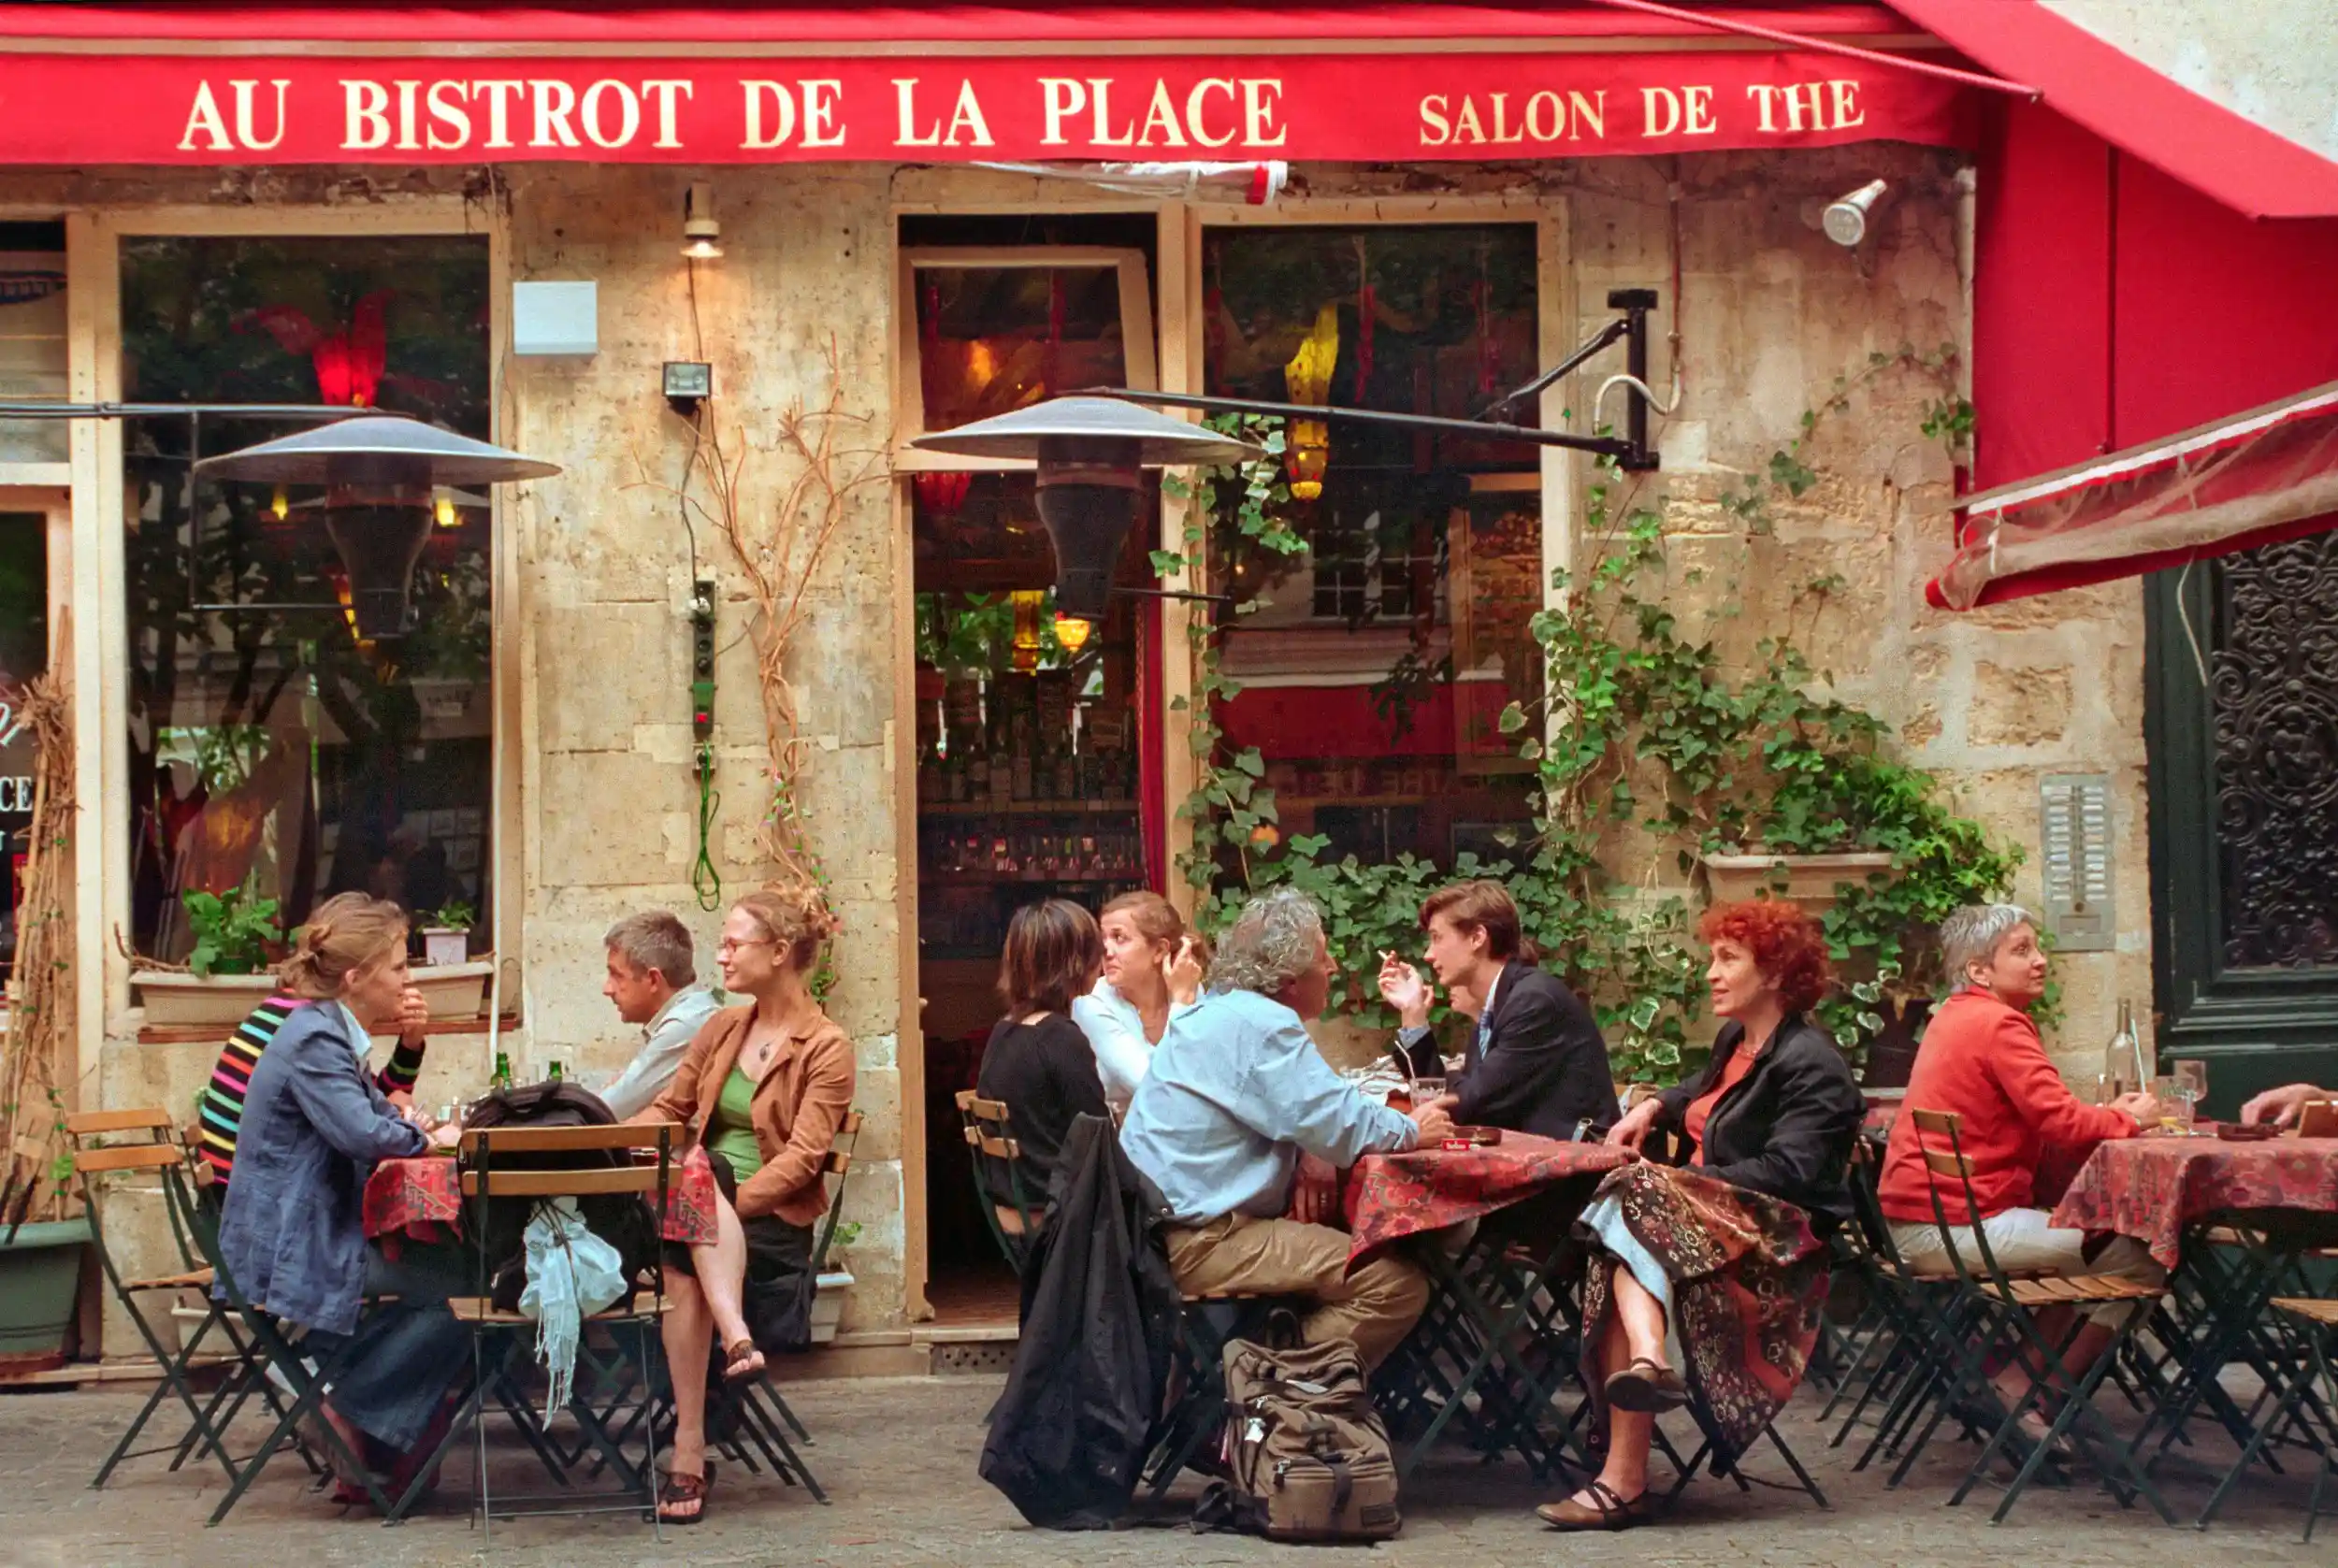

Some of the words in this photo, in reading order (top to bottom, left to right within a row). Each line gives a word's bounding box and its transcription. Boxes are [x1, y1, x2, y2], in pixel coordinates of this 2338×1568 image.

[176, 79, 292, 151] AU
[339, 79, 694, 151] BISTROT
[739, 78, 846, 150] DE
[890, 78, 997, 148] LA
[1037, 77, 1288, 148] PLACE
[1419, 90, 1607, 147] SALON
[1640, 85, 1719, 137] DE
[1746, 79, 1866, 133] THE
